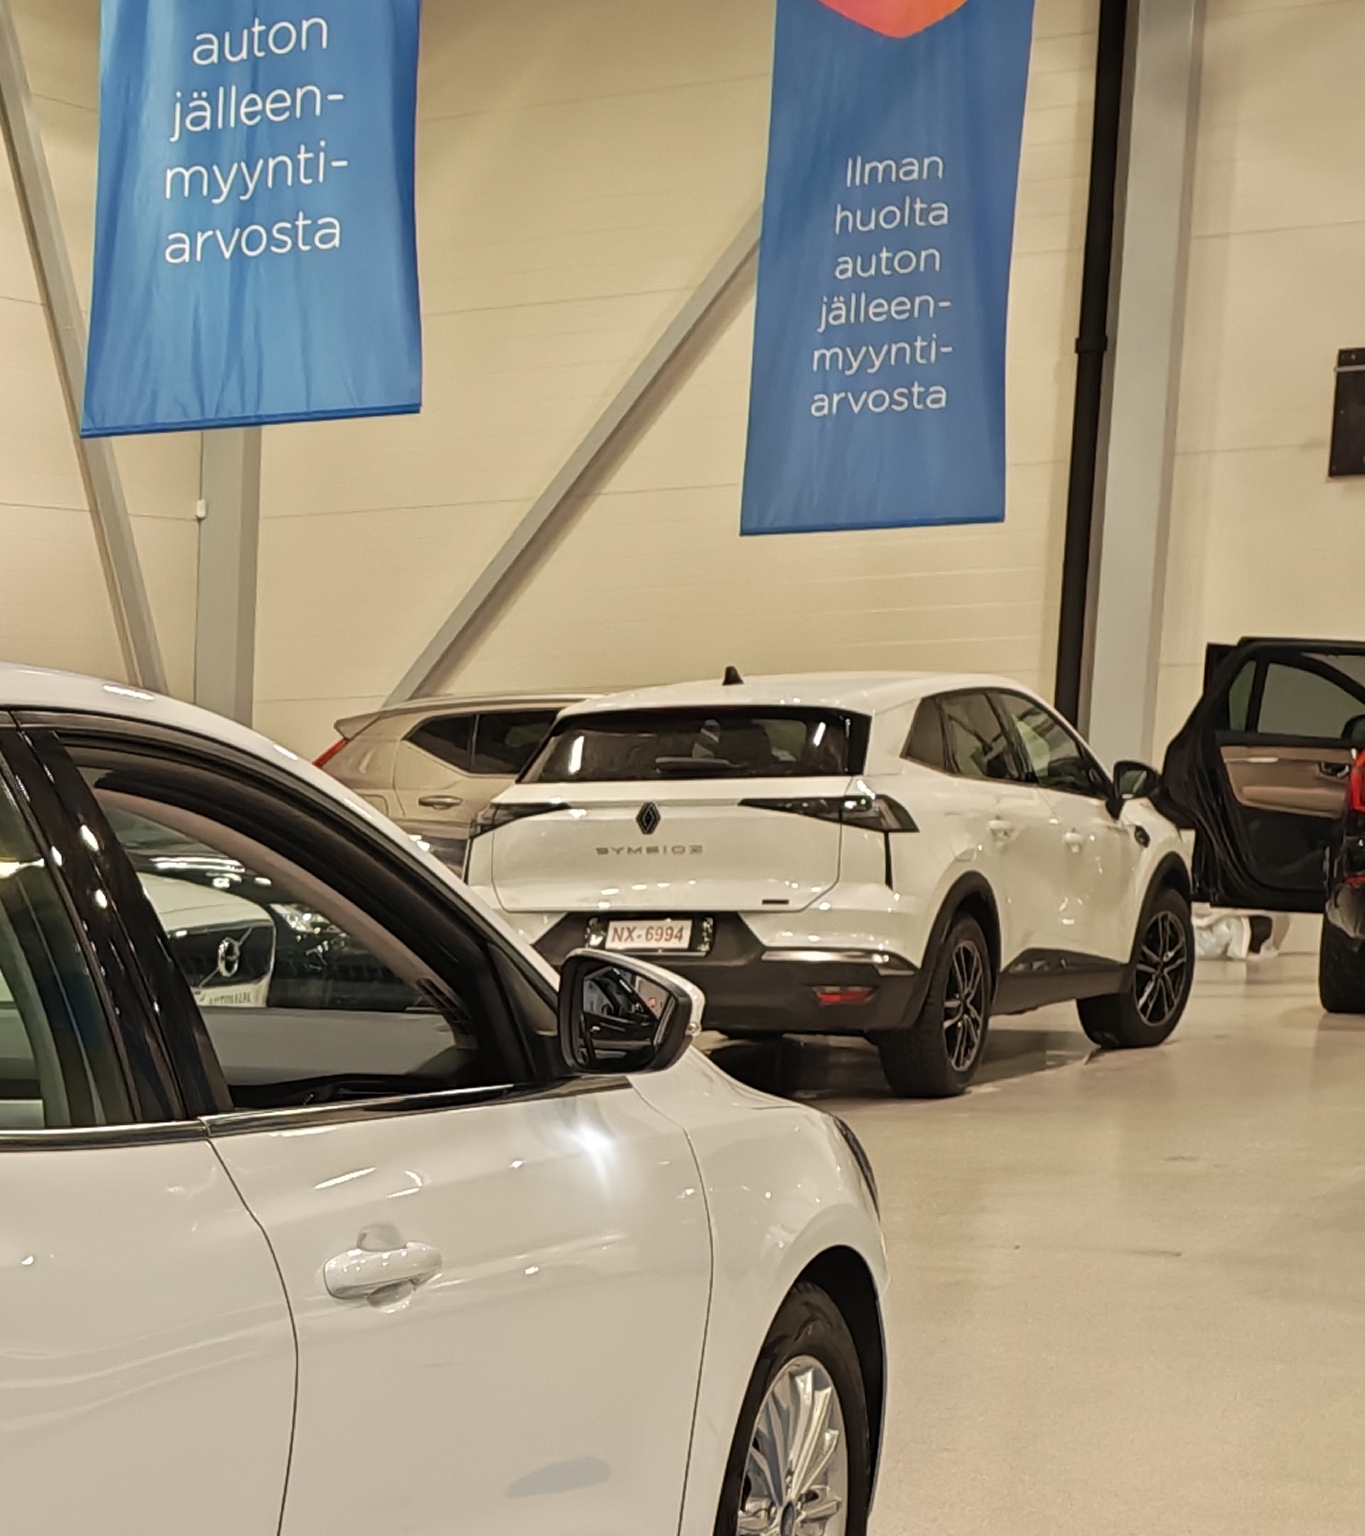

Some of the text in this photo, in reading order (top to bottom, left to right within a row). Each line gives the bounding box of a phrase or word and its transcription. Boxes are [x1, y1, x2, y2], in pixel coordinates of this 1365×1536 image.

[192, 17, 328, 66] auton
[169, 84, 345, 143] jälleen-
[164, 140, 349, 205] myynti-
[845, 154, 945, 188] Ilman
[834, 195, 949, 235] huolta
[164, 210, 341, 264] arvosta
[834, 246, 941, 280] auton
[816, 292, 952, 334] jälleen-
[812, 333, 953, 376] myynti-
[810, 381, 947, 418] arvosta
